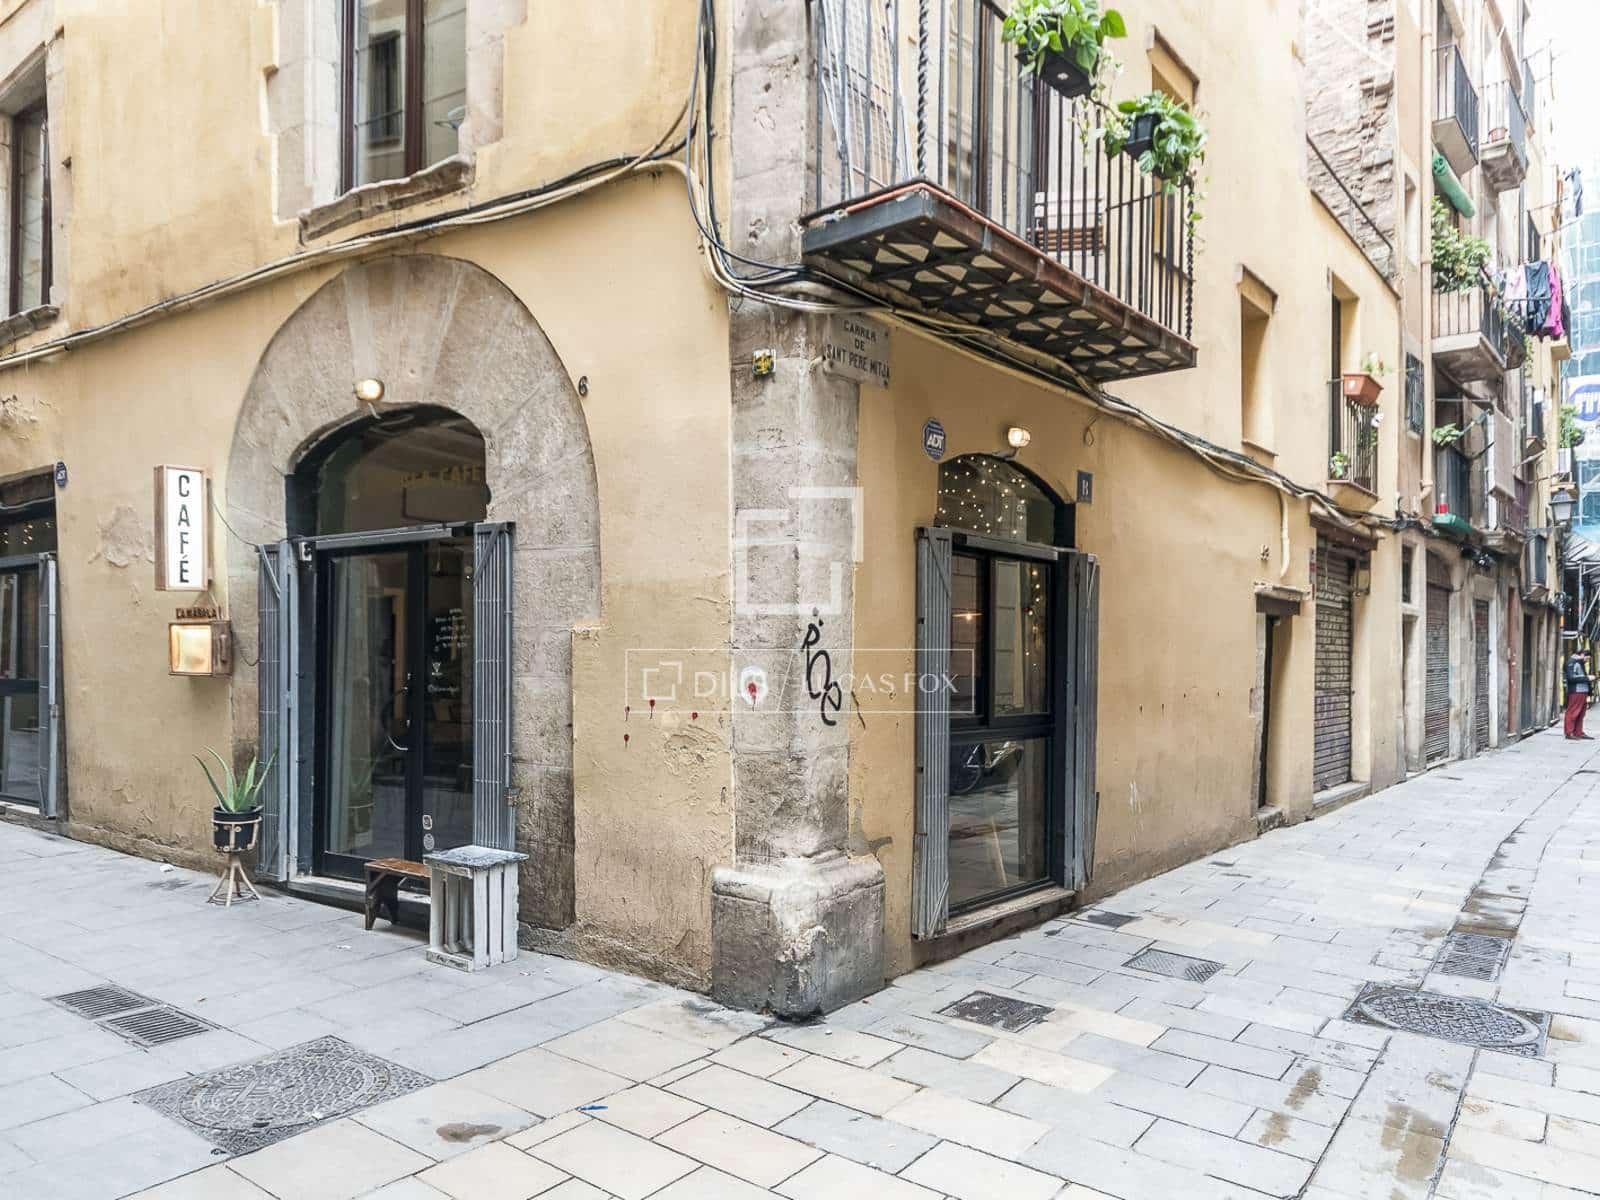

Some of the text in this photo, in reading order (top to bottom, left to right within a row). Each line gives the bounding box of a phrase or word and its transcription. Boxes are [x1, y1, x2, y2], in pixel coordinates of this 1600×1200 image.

[843, 320, 876, 342] CARRER
[826, 343, 847, 364] SANT
[854, 338, 865, 351] DE
[578, 375, 588, 397] 6
[927, 433, 944, 449] ADT
[178, 474, 190, 583] CAFÉ
